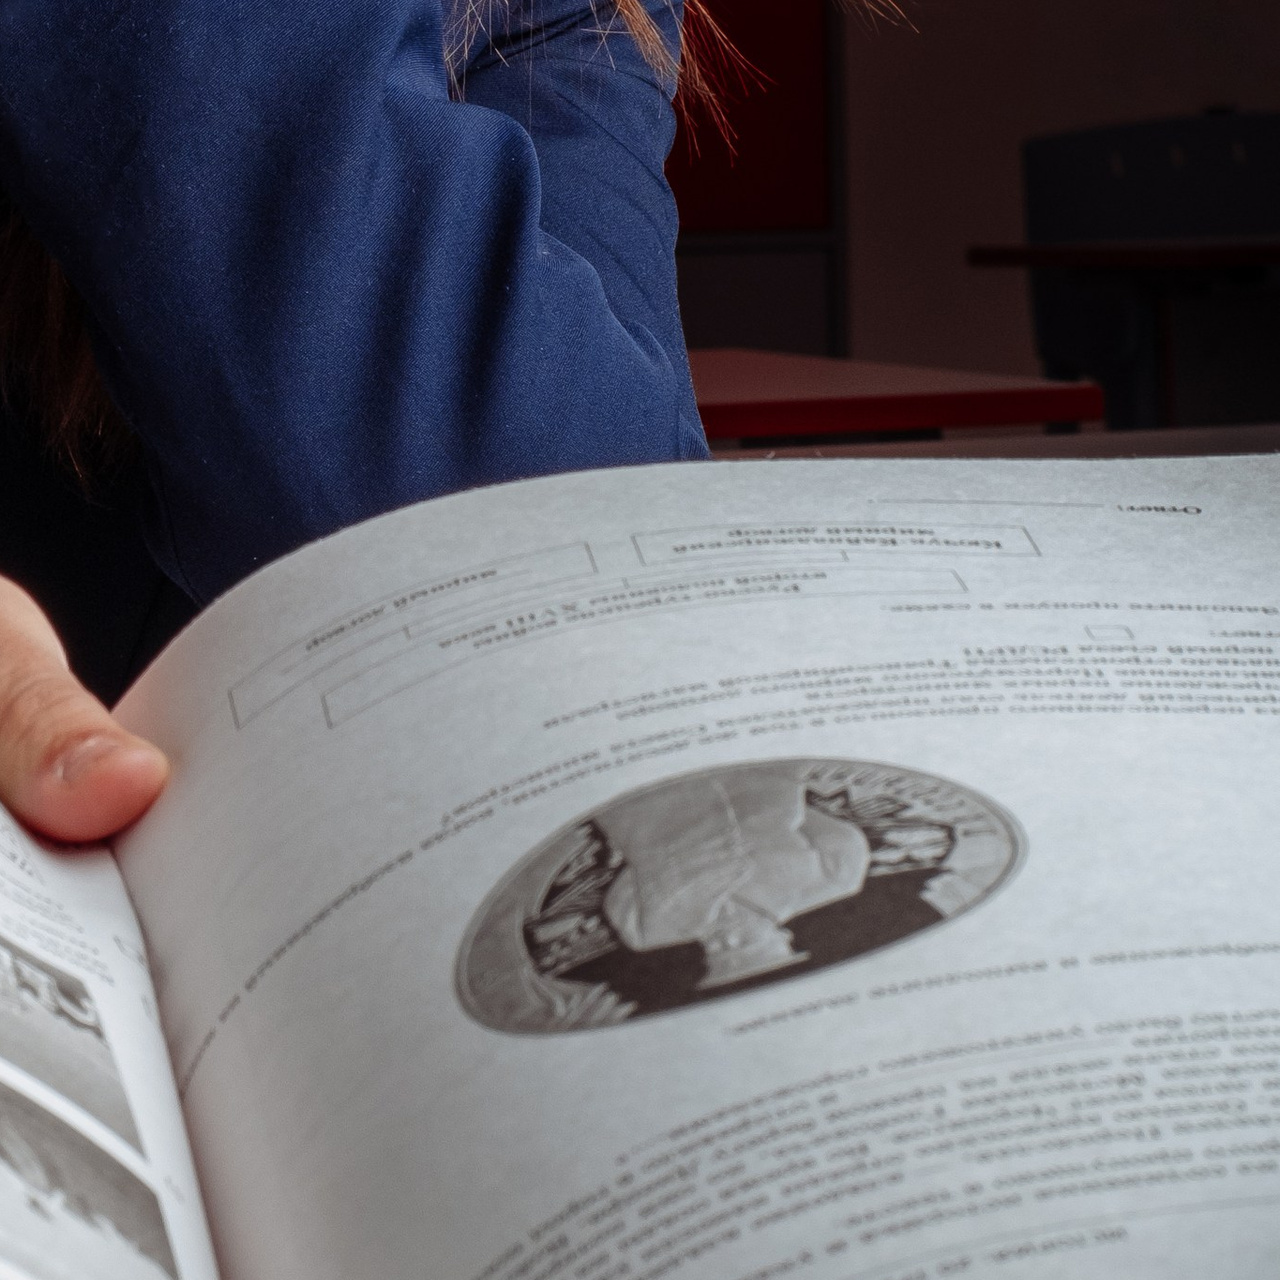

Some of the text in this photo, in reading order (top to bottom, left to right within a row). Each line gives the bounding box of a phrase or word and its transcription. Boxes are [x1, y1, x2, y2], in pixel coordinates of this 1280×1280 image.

[827, 525, 936, 536] мирный
[394, 567, 499, 608] мирный
[734, 570, 828, 585] второй
[588, 577, 726, 607] половины
